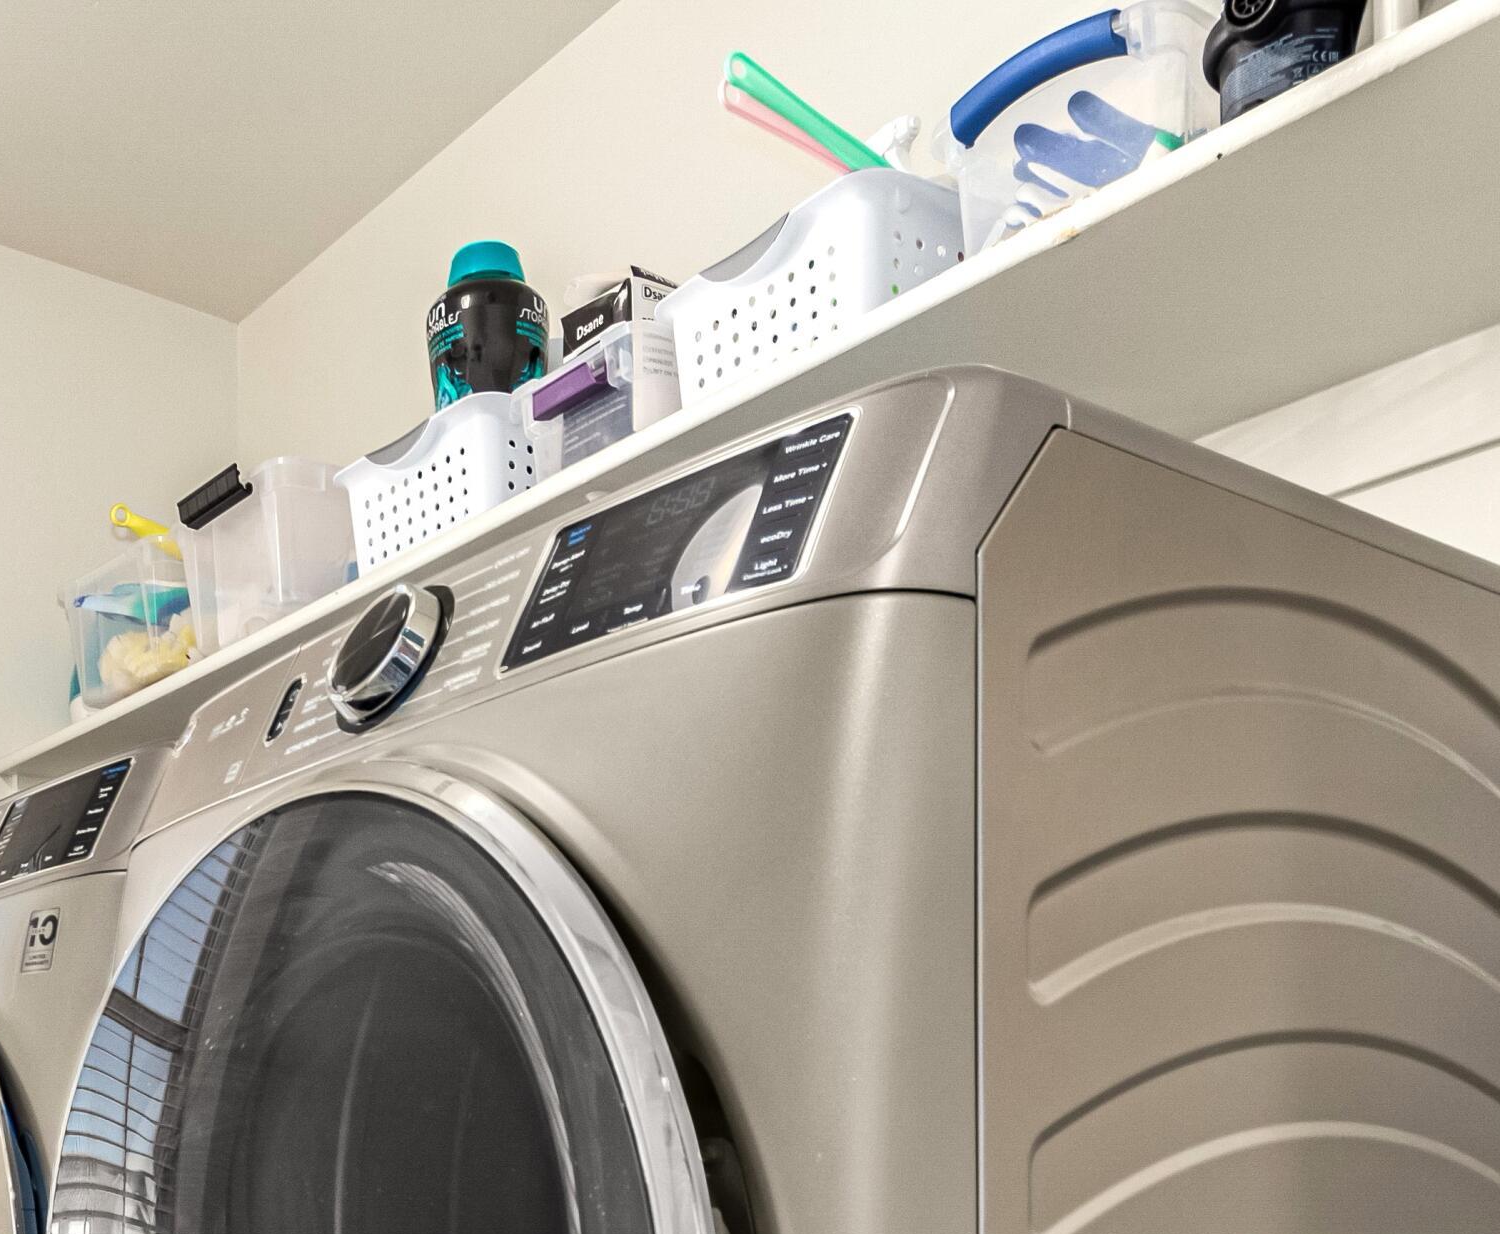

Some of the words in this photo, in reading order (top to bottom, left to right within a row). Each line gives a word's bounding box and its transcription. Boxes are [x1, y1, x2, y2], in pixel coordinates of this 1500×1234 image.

[643, 286, 667, 301] Dsa
[576, 314, 604, 341] Dsane
[819, 431, 841, 444] Care
[774, 470, 796, 483] More
[798, 464, 820, 477] Time
[762, 504, 783, 515] Less
[785, 496, 806, 508] Time
[29, 914, 59, 947] 10
